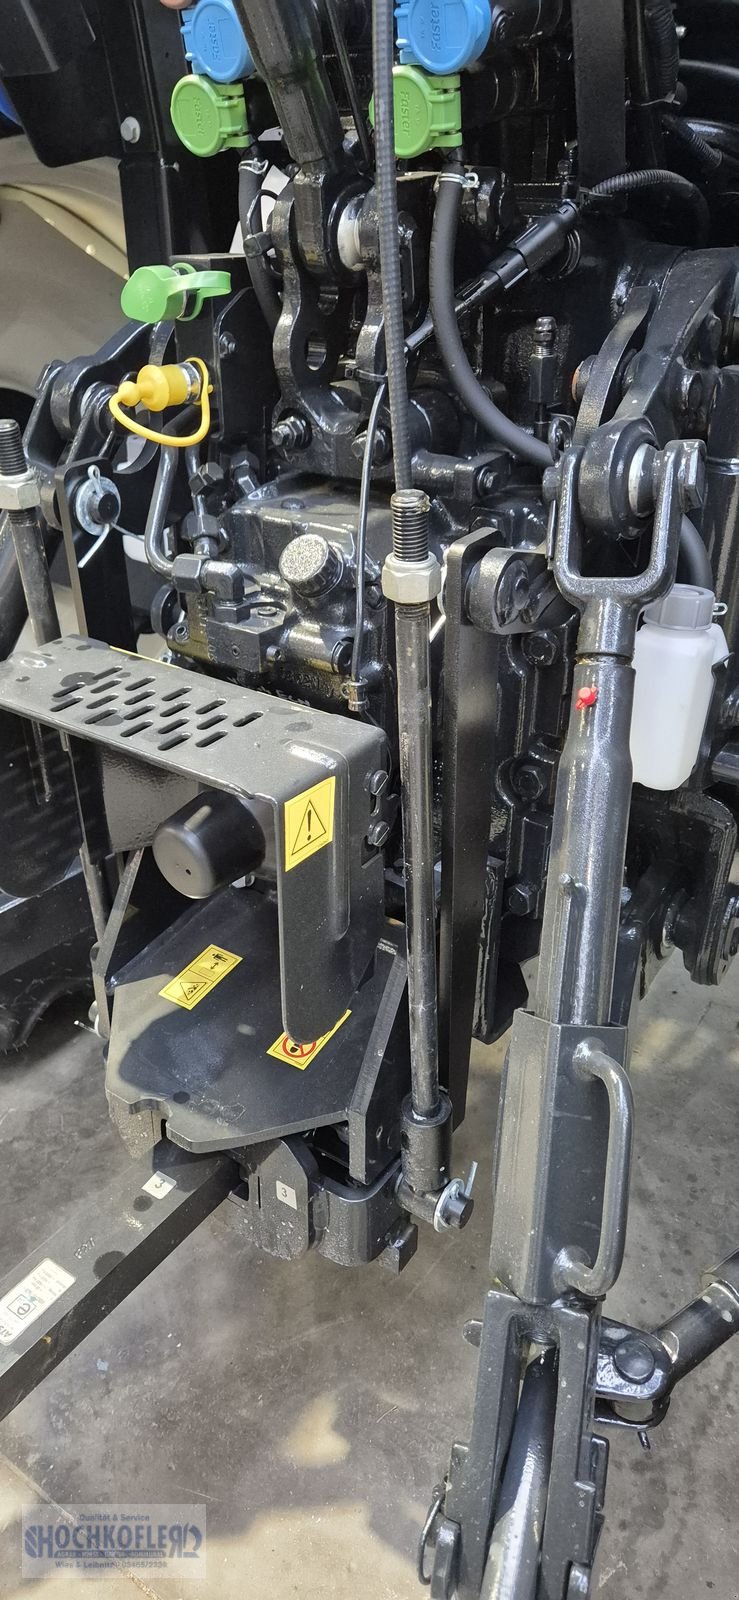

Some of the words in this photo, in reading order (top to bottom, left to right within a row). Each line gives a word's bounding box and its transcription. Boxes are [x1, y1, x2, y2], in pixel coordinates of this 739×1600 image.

[430, 1, 441, 51] Faster
[400, 90, 411, 137] Faster
[154, 1178, 166, 1190] 3
[281, 1186, 288, 1199] 3
